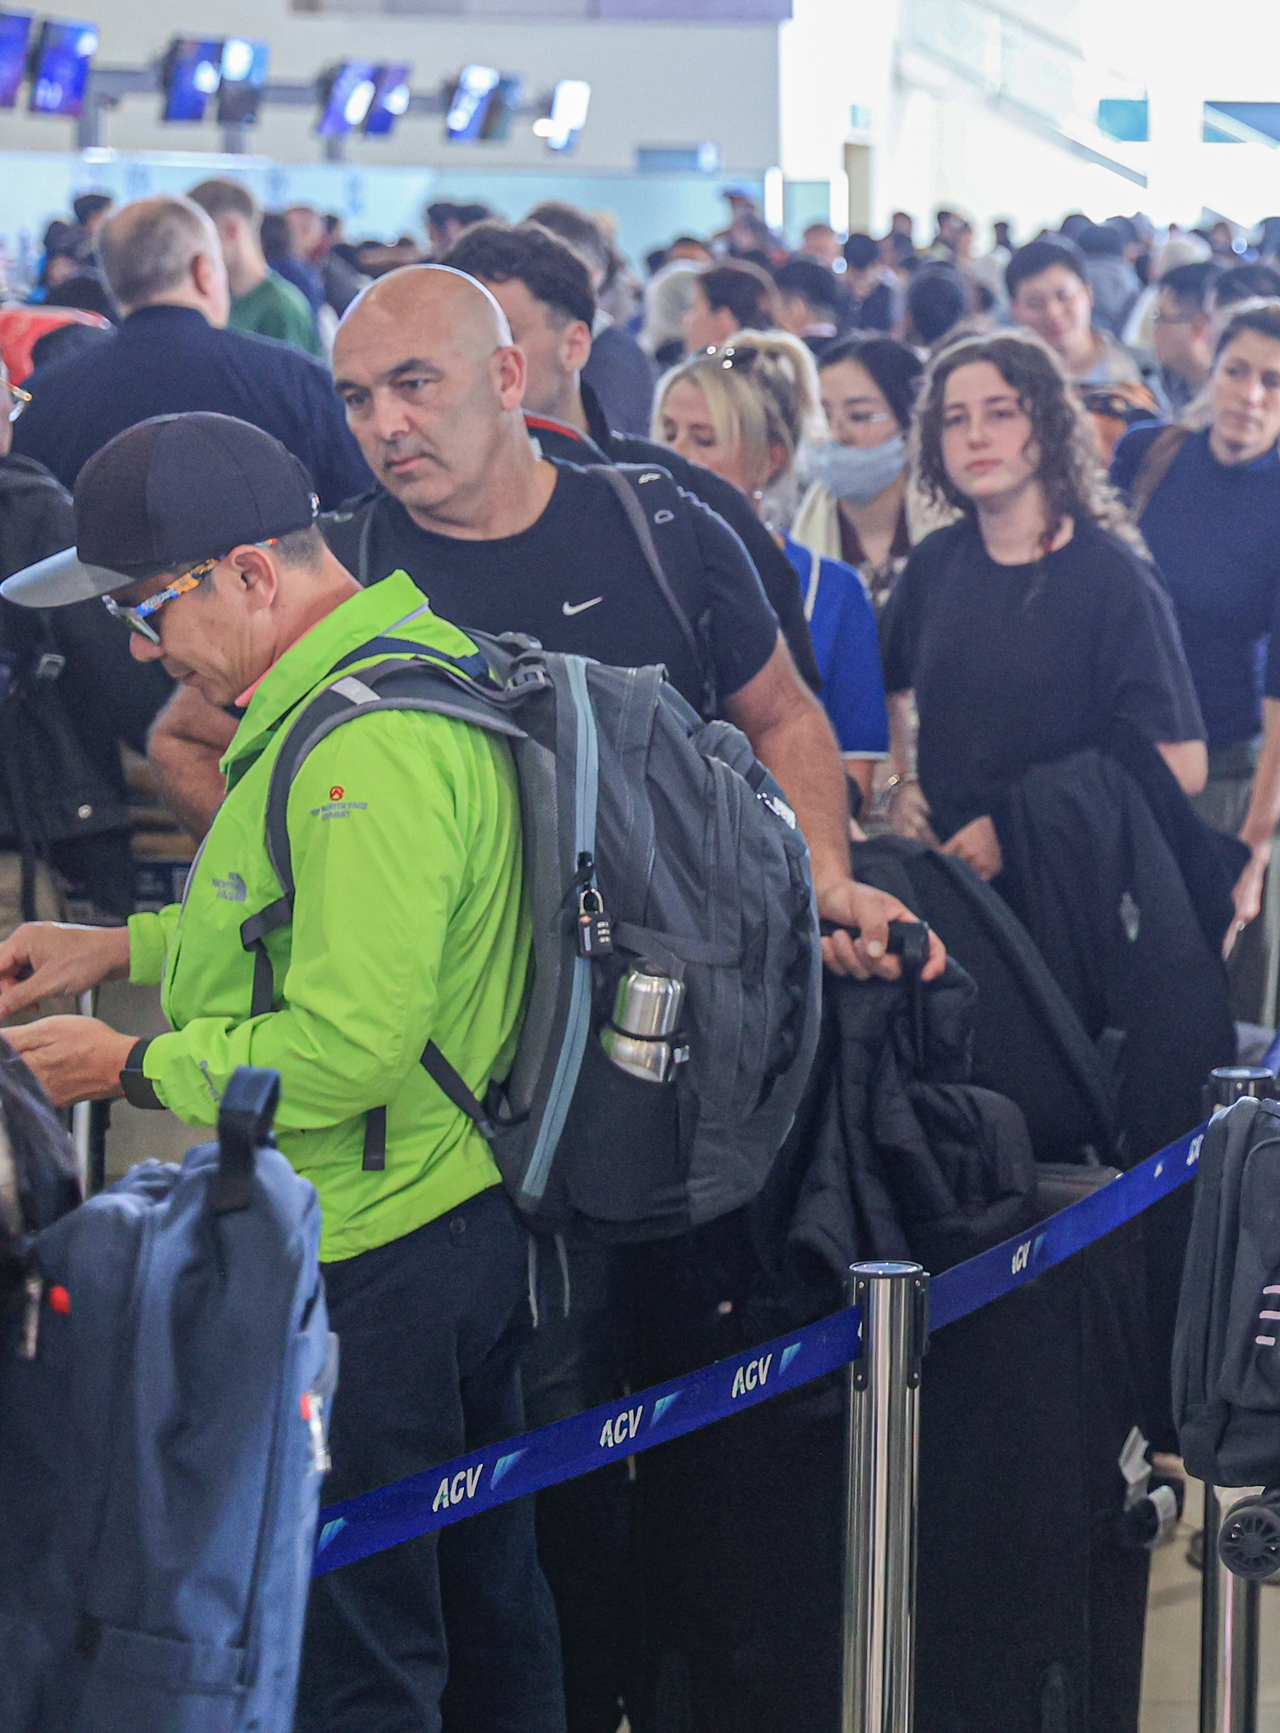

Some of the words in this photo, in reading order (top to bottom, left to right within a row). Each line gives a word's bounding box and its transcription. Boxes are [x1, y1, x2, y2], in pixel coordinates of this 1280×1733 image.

[731, 1353, 773, 1399] ACV
[599, 1405, 644, 1448] ACV
[432, 1463, 484, 1513] ACV
